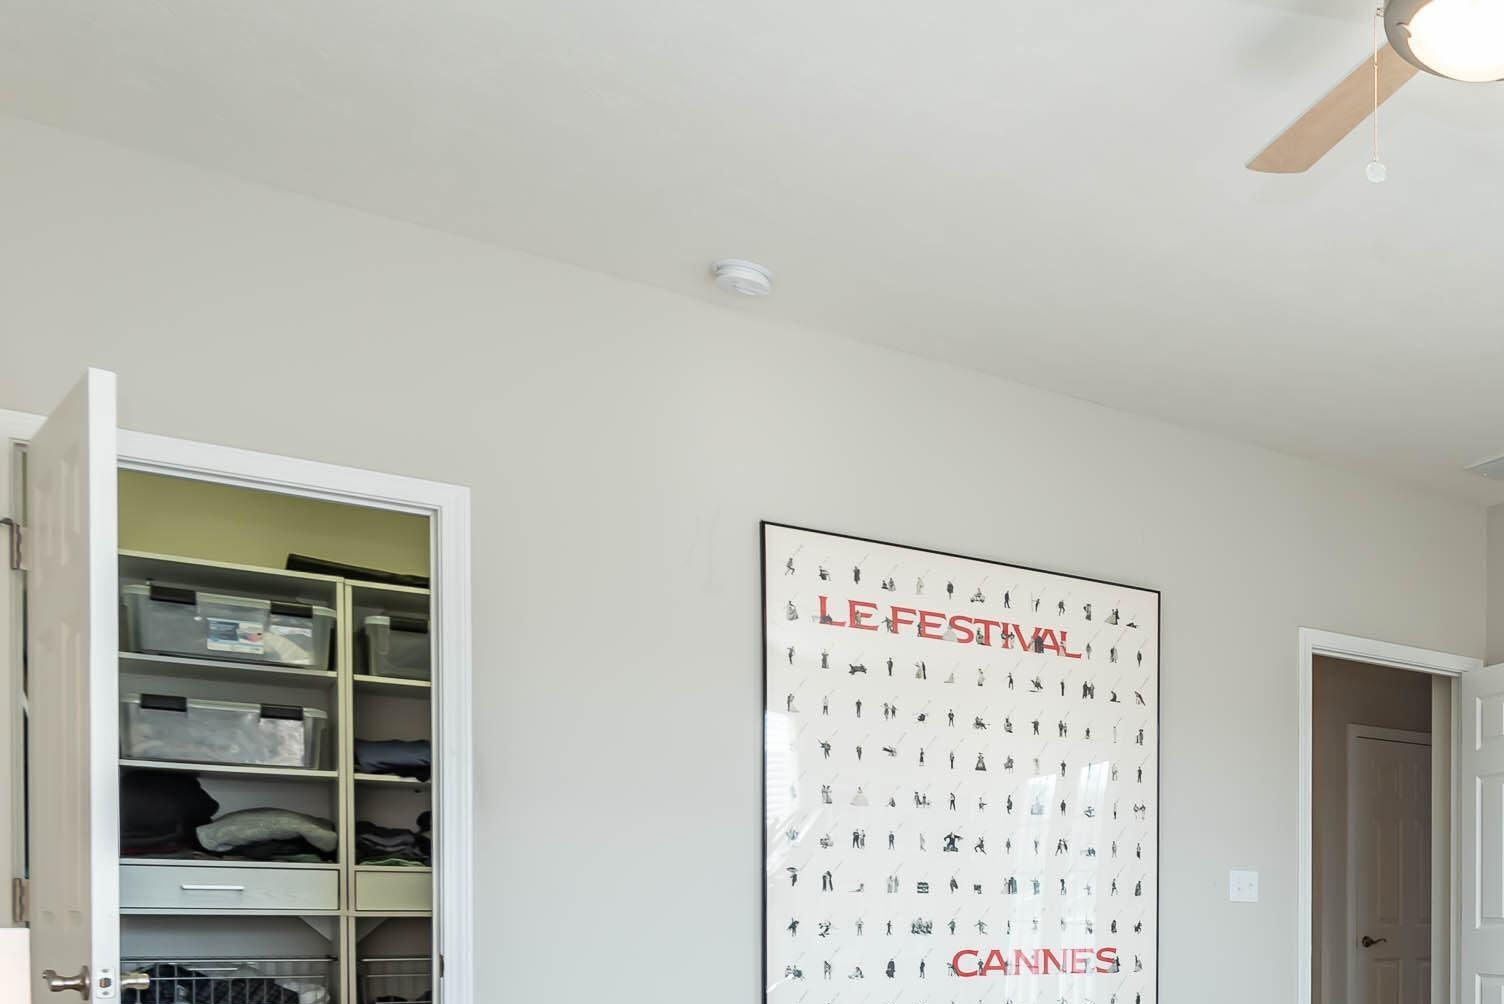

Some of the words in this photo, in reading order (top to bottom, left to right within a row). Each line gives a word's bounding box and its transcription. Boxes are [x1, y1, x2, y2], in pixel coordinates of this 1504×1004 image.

[818, 595, 880, 631] LE
[889, 604, 1082, 659] FESTIVAL
[952, 947, 1118, 977] CANNES
